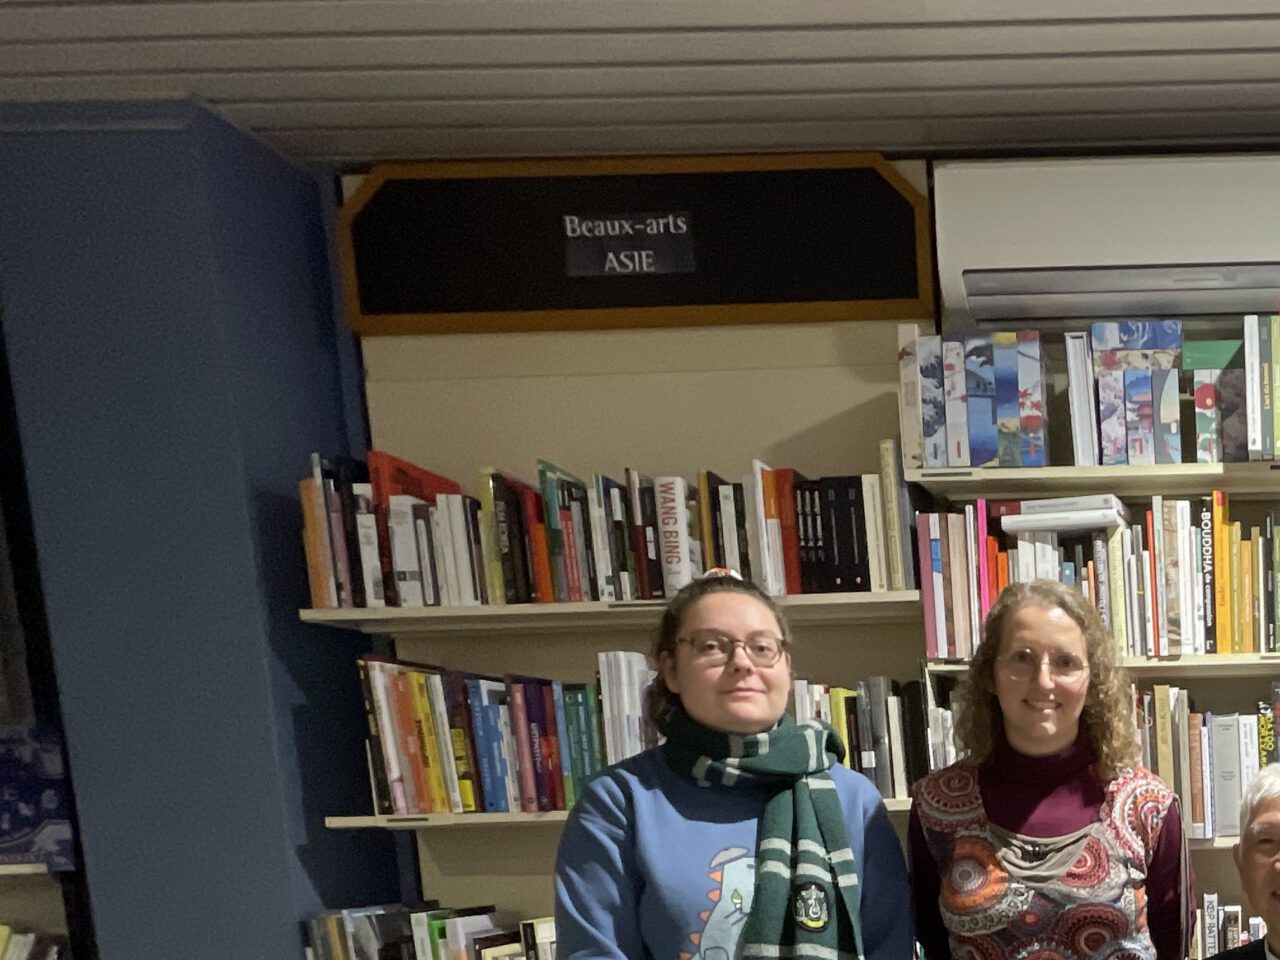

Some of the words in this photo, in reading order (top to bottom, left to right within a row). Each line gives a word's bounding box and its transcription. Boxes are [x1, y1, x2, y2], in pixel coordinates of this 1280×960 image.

[563, 213, 687, 237] Beaux-arts
[604, 250, 656, 273] ASIE
[658, 481, 681, 527] WANG
[663, 529, 683, 566] BING
